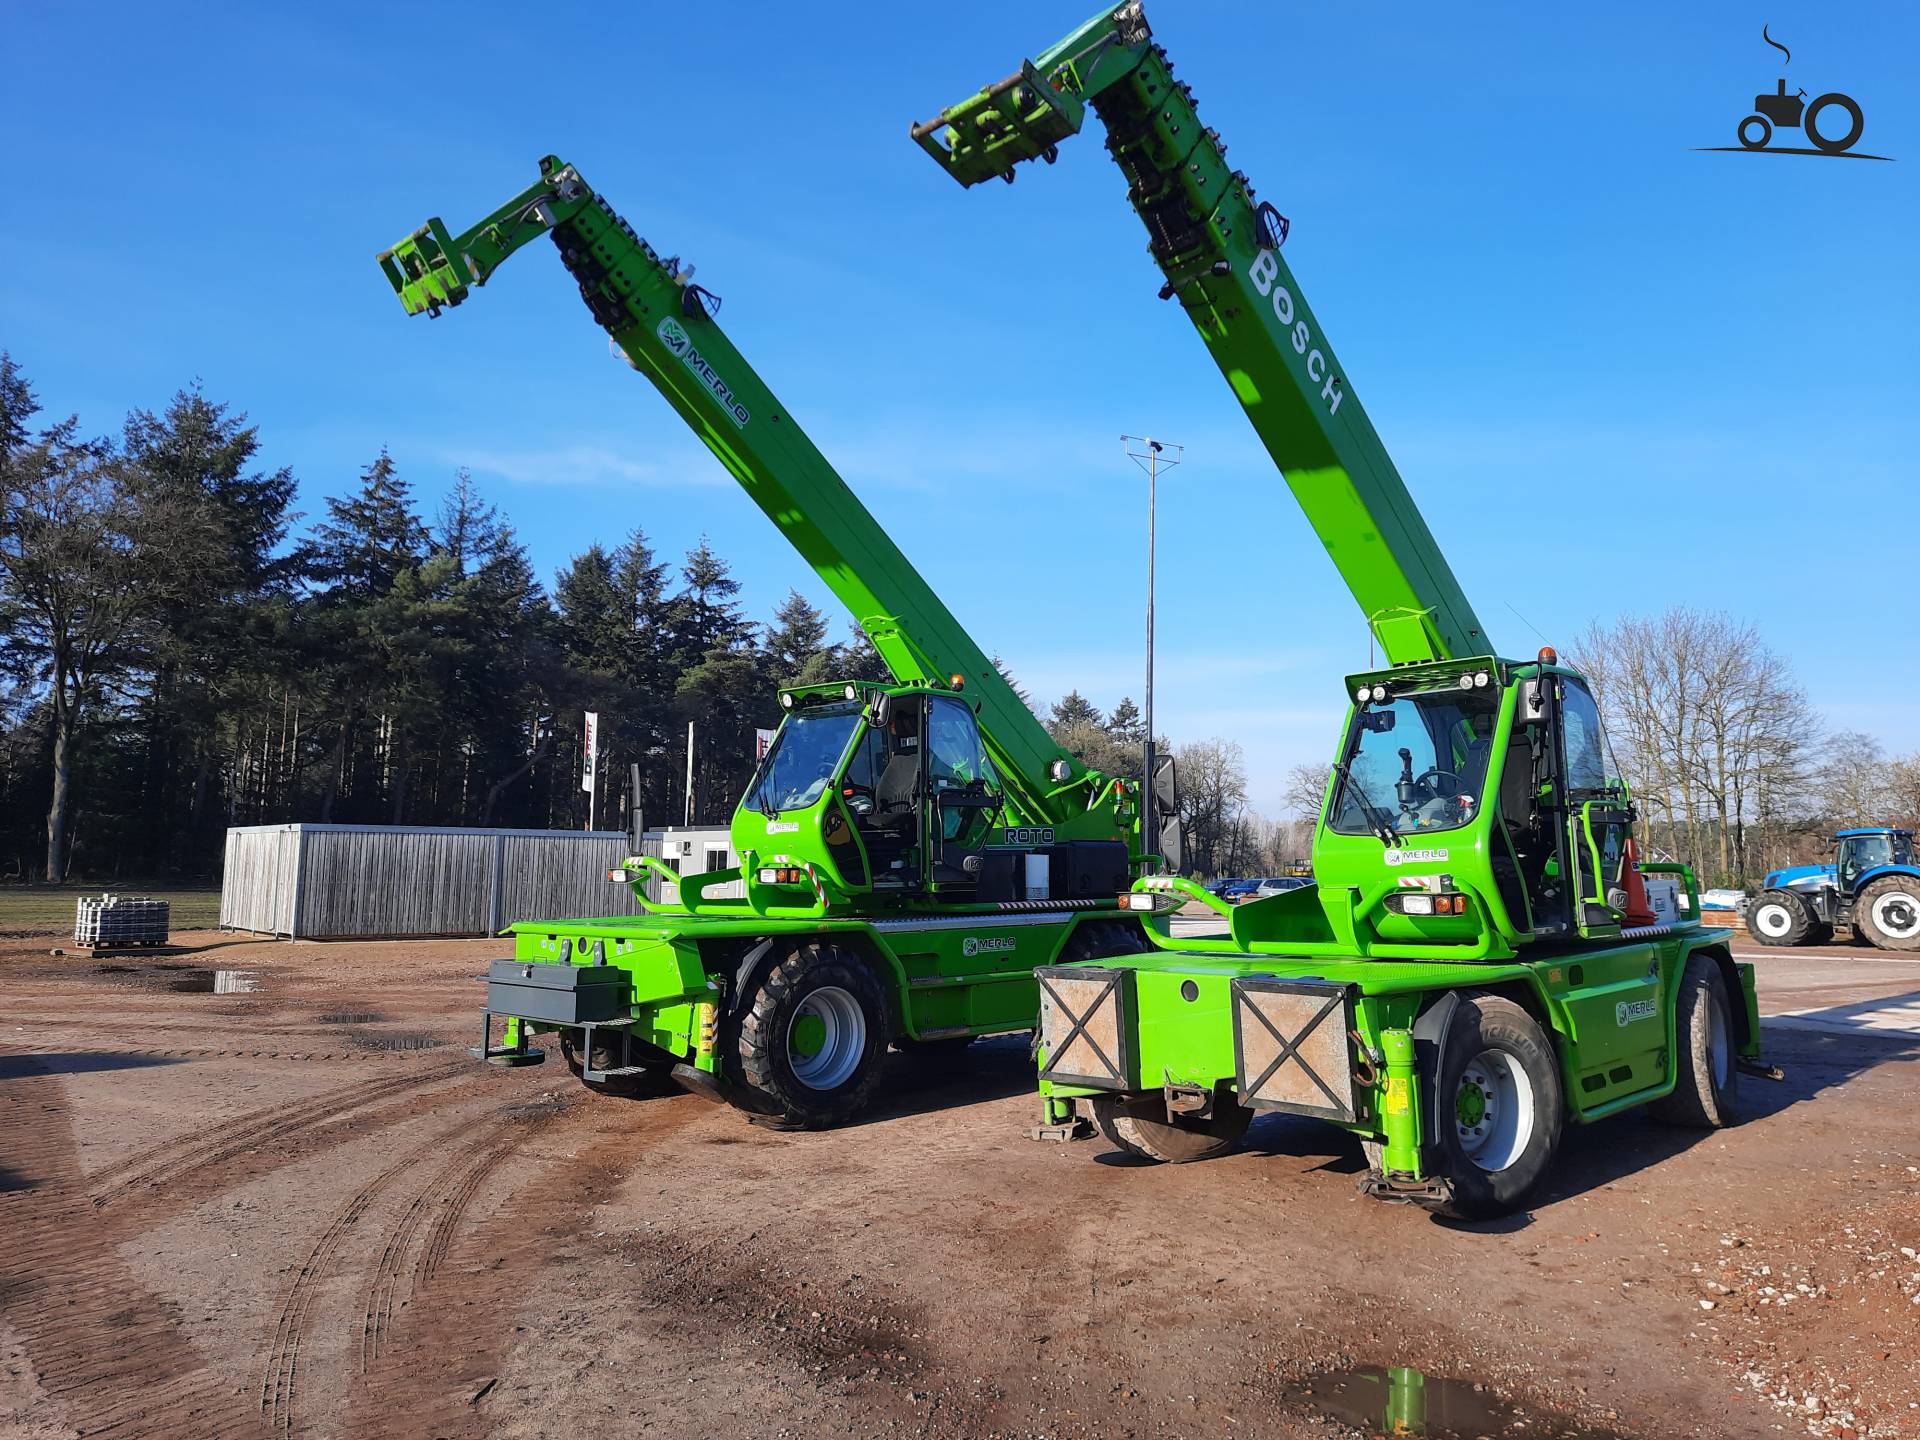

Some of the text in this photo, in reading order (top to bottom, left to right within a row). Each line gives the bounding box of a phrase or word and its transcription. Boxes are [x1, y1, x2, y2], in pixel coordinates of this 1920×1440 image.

[1249, 248, 1343, 416] BOSCH
[686, 348, 750, 424] MERLO
[1004, 827, 1055, 845] ROTO
[1403, 849, 1448, 859] MERLO
[979, 937, 1016, 948] MERLO
[1628, 999, 1656, 1015] MERLO
[1481, 1024, 1539, 1058] ICHELIN
